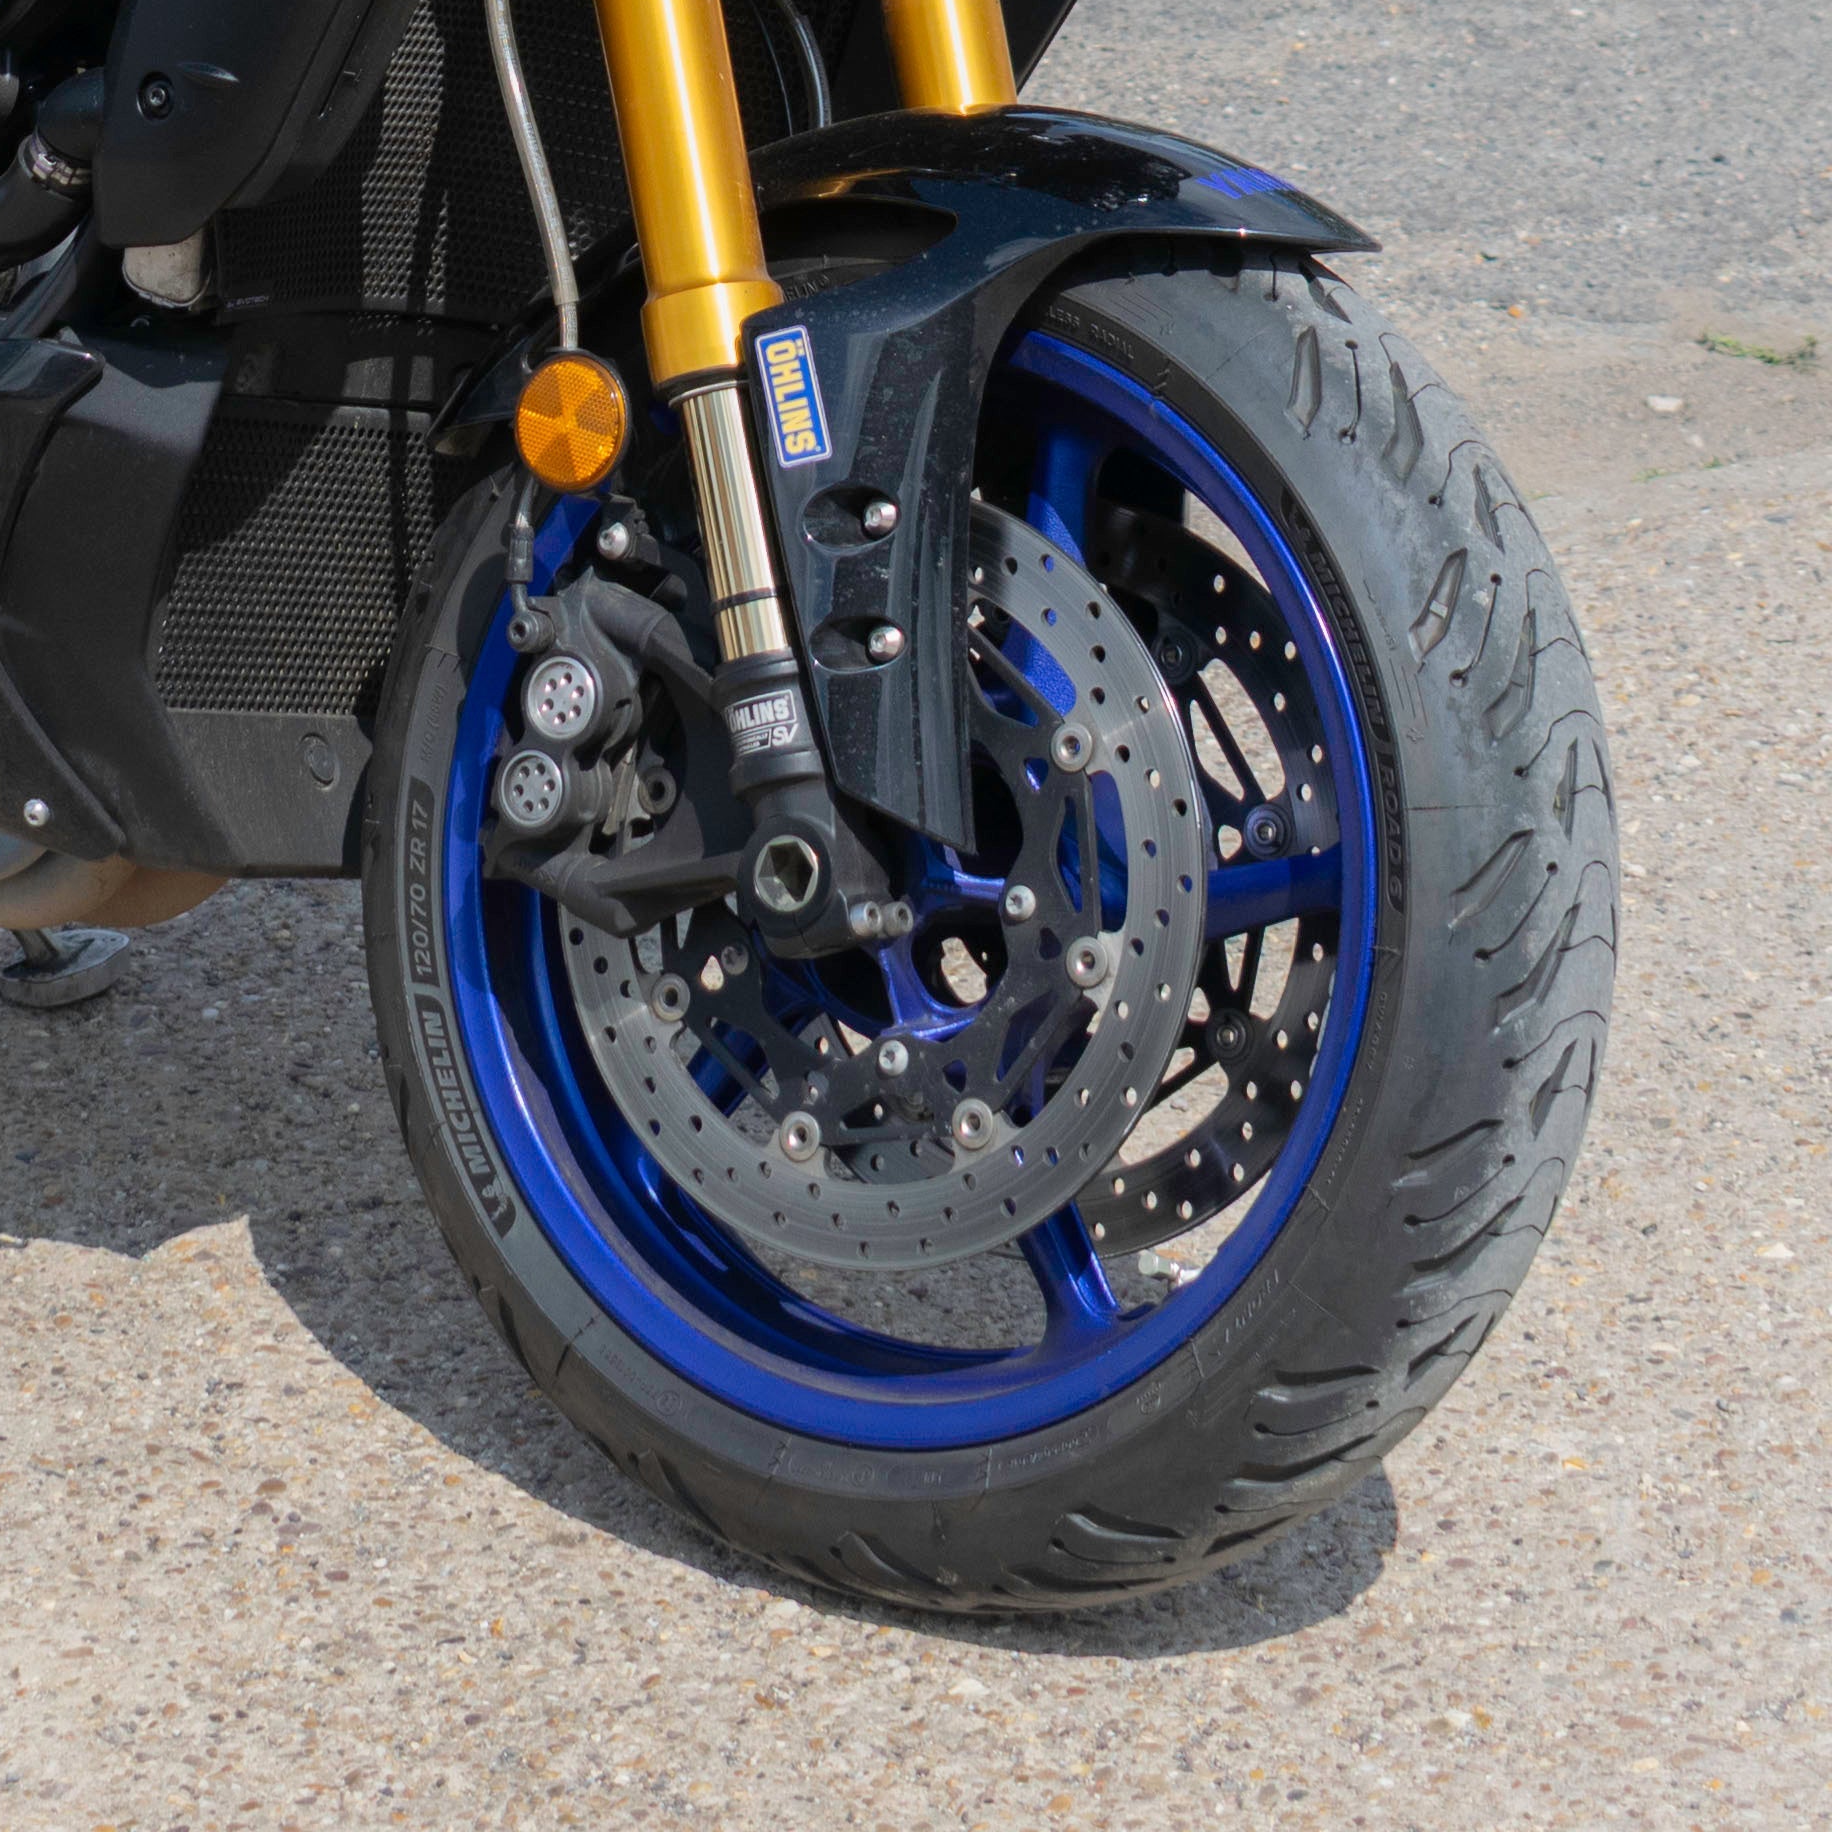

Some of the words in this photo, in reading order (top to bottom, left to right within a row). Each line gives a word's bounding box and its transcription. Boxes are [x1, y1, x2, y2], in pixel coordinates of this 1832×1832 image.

[765, 337, 819, 456] ÖHLINS
[1310, 551, 1385, 726] MICHELIN
[409, 835, 428, 875] ZR
[411, 799, 428, 825] 17
[1382, 765, 1403, 865] ROAD
[409, 882, 433, 977] 120/70
[421, 1009, 491, 1176] MICHELIN
